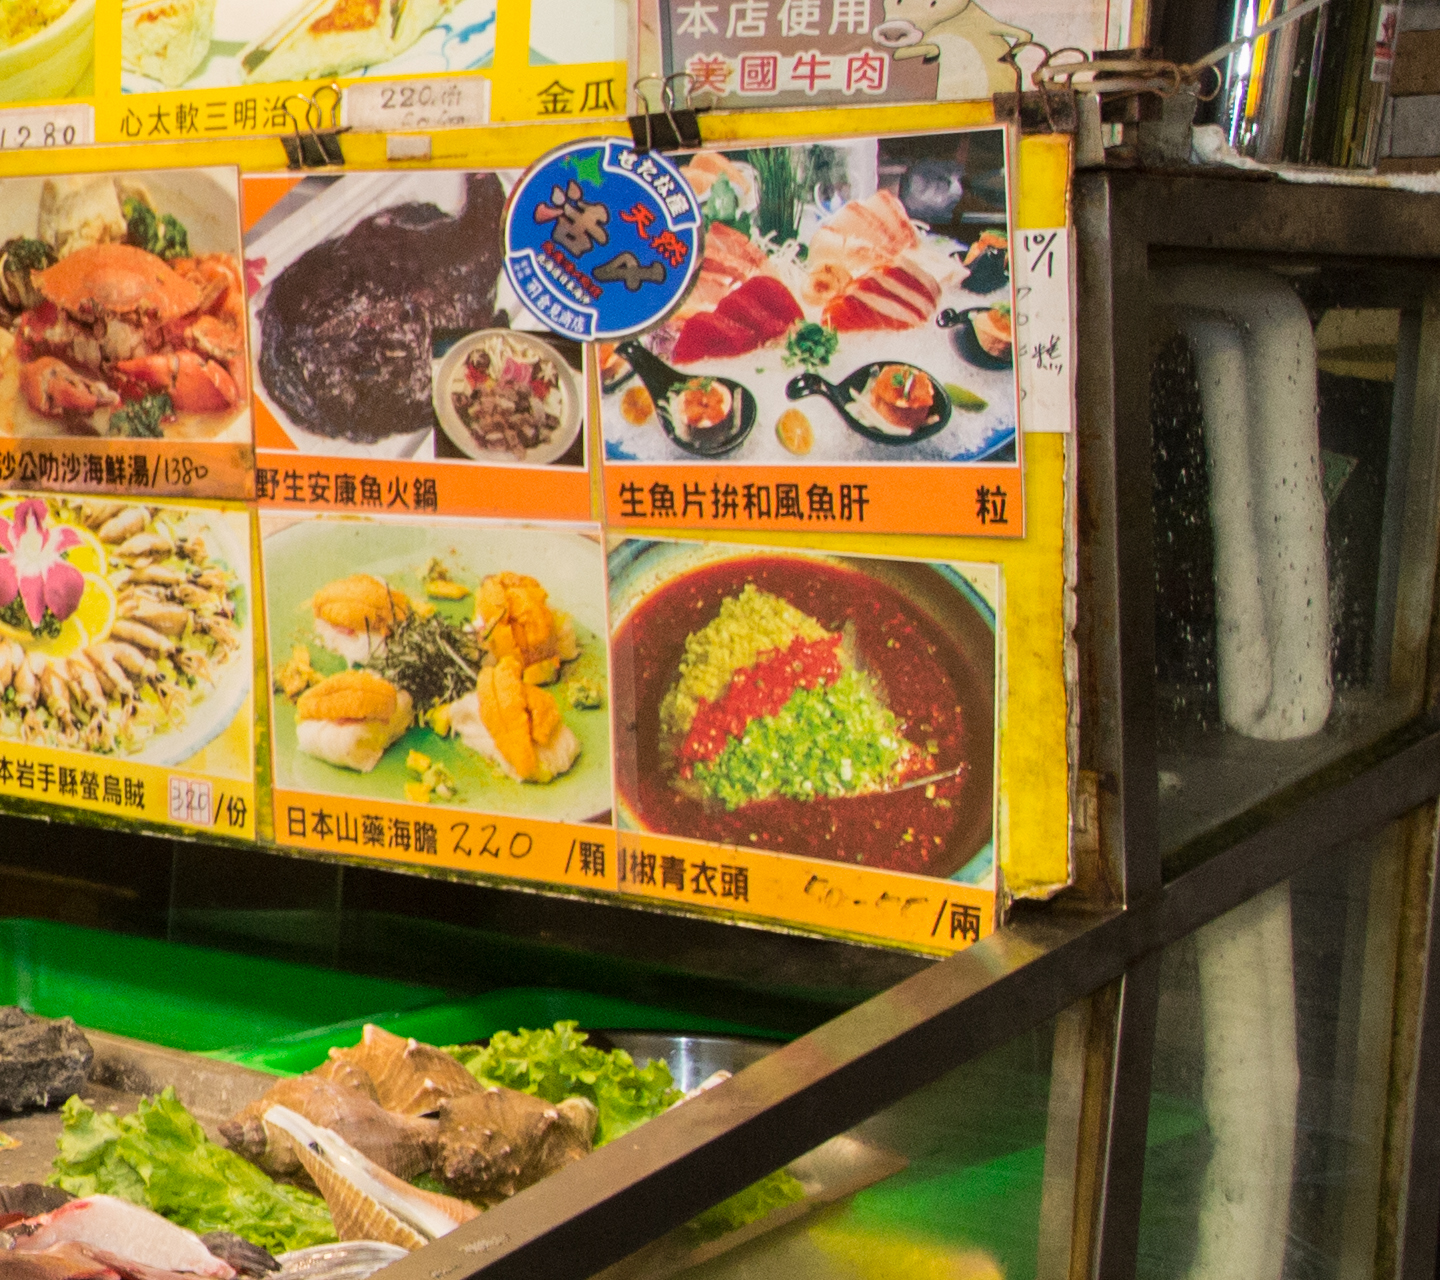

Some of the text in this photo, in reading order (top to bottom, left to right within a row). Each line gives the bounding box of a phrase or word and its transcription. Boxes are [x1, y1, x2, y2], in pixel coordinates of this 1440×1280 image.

[689, 50, 887, 98] 美國牛肉
[119, 95, 288, 137] 心太軟三明治
[536, 78, 619, 117] 金瓜
[255, 469, 440, 514] 野生安康魚火鍋
[975, 485, 1009, 527] 粒
[212, 794, 248, 831] /份
[450, 820, 534, 862] 220
[618, 848, 750, 904] 椒青衣頭
[930, 898, 982, 944] /兩
